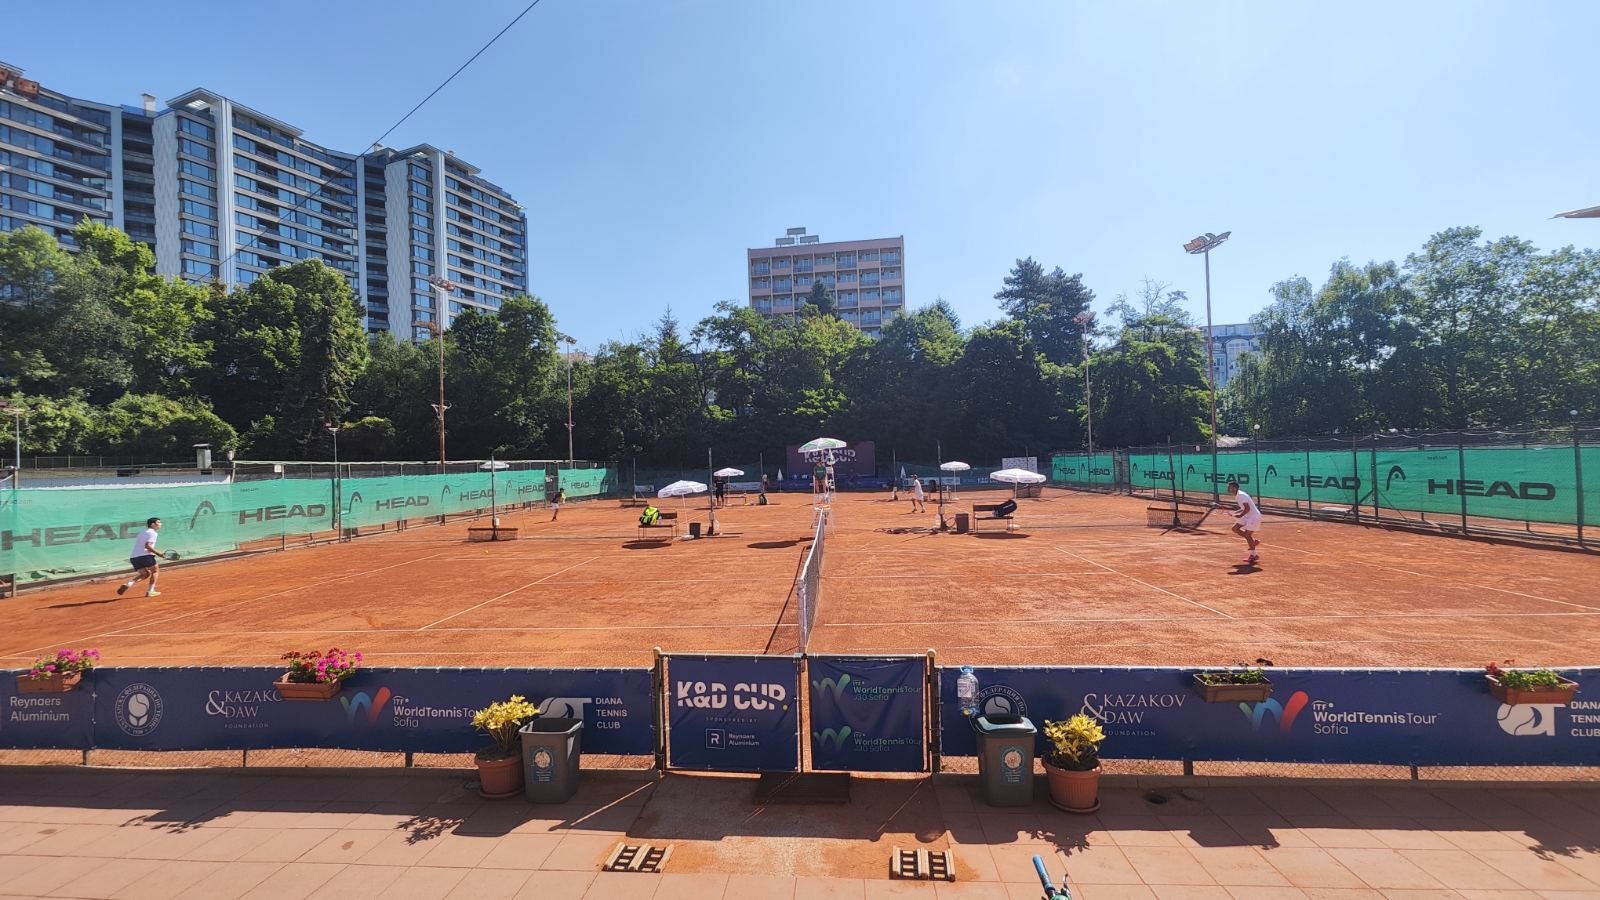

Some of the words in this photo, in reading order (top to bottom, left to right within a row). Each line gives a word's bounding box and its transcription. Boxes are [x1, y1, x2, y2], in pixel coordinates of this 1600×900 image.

[1089, 468, 1110, 476] HEAD
[1144, 471, 1175, 480] HEAD
[1204, 473, 1249, 484] HEAD
[1290, 475, 1360, 489] HEAD
[460, 488, 496, 501] HEAD
[518, 484, 545, 494] HEAD
[1428, 479, 1556, 500] HEAD
[376, 495, 430, 511] HEAD
[239, 504, 326, 525] HEAD
[677, 680, 727, 709] K&D
[853, 685, 921, 694] WorldTennisTour
[225, 690, 281, 703] KAZAKO
[869, 693, 889, 701] Sofia
[1104, 694, 1186, 708] KAZAKOV
[1312, 701, 1328, 710] ITF
[10, 710, 70, 721] Aluminium
[225, 706, 259, 718] DAW
[394, 706, 477, 718] WorldTennisTo
[596, 709, 628, 717] TENNIS
[1104, 711, 1144, 724] DAW
[1313, 711, 1437, 724] WorldTennisTour
[393, 717, 419, 728] Sofia
[1570, 714, 1600, 723] TENN
[596, 721, 621, 729] CLUB
[1313, 723, 1349, 734] Sofia
[1570, 728, 1600, 736] CLUB
